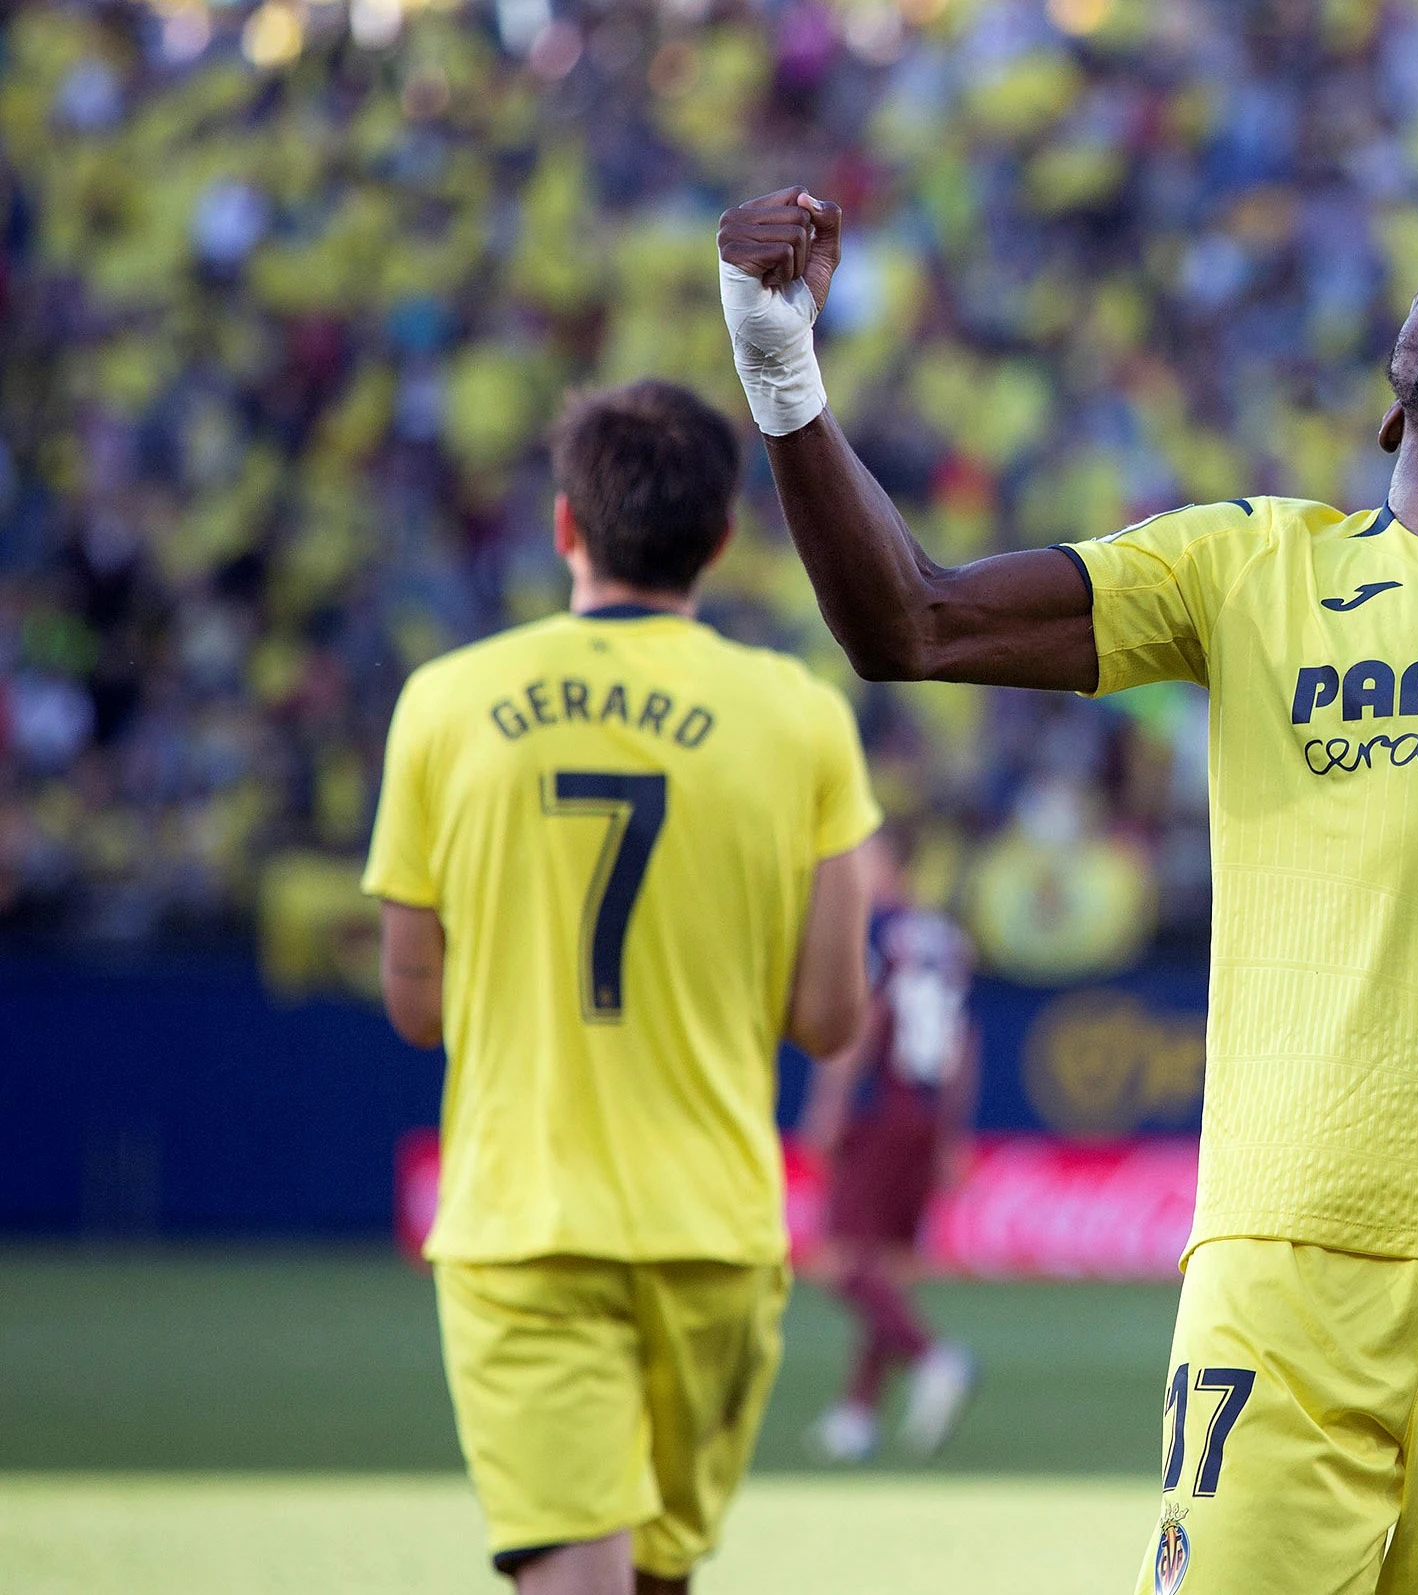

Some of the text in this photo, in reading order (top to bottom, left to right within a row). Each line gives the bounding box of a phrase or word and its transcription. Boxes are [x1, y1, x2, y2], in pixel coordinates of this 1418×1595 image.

[490, 676, 718, 749] GERARD
[540, 770, 668, 1026] 7
[1161, 1362, 1257, 1498] 17
